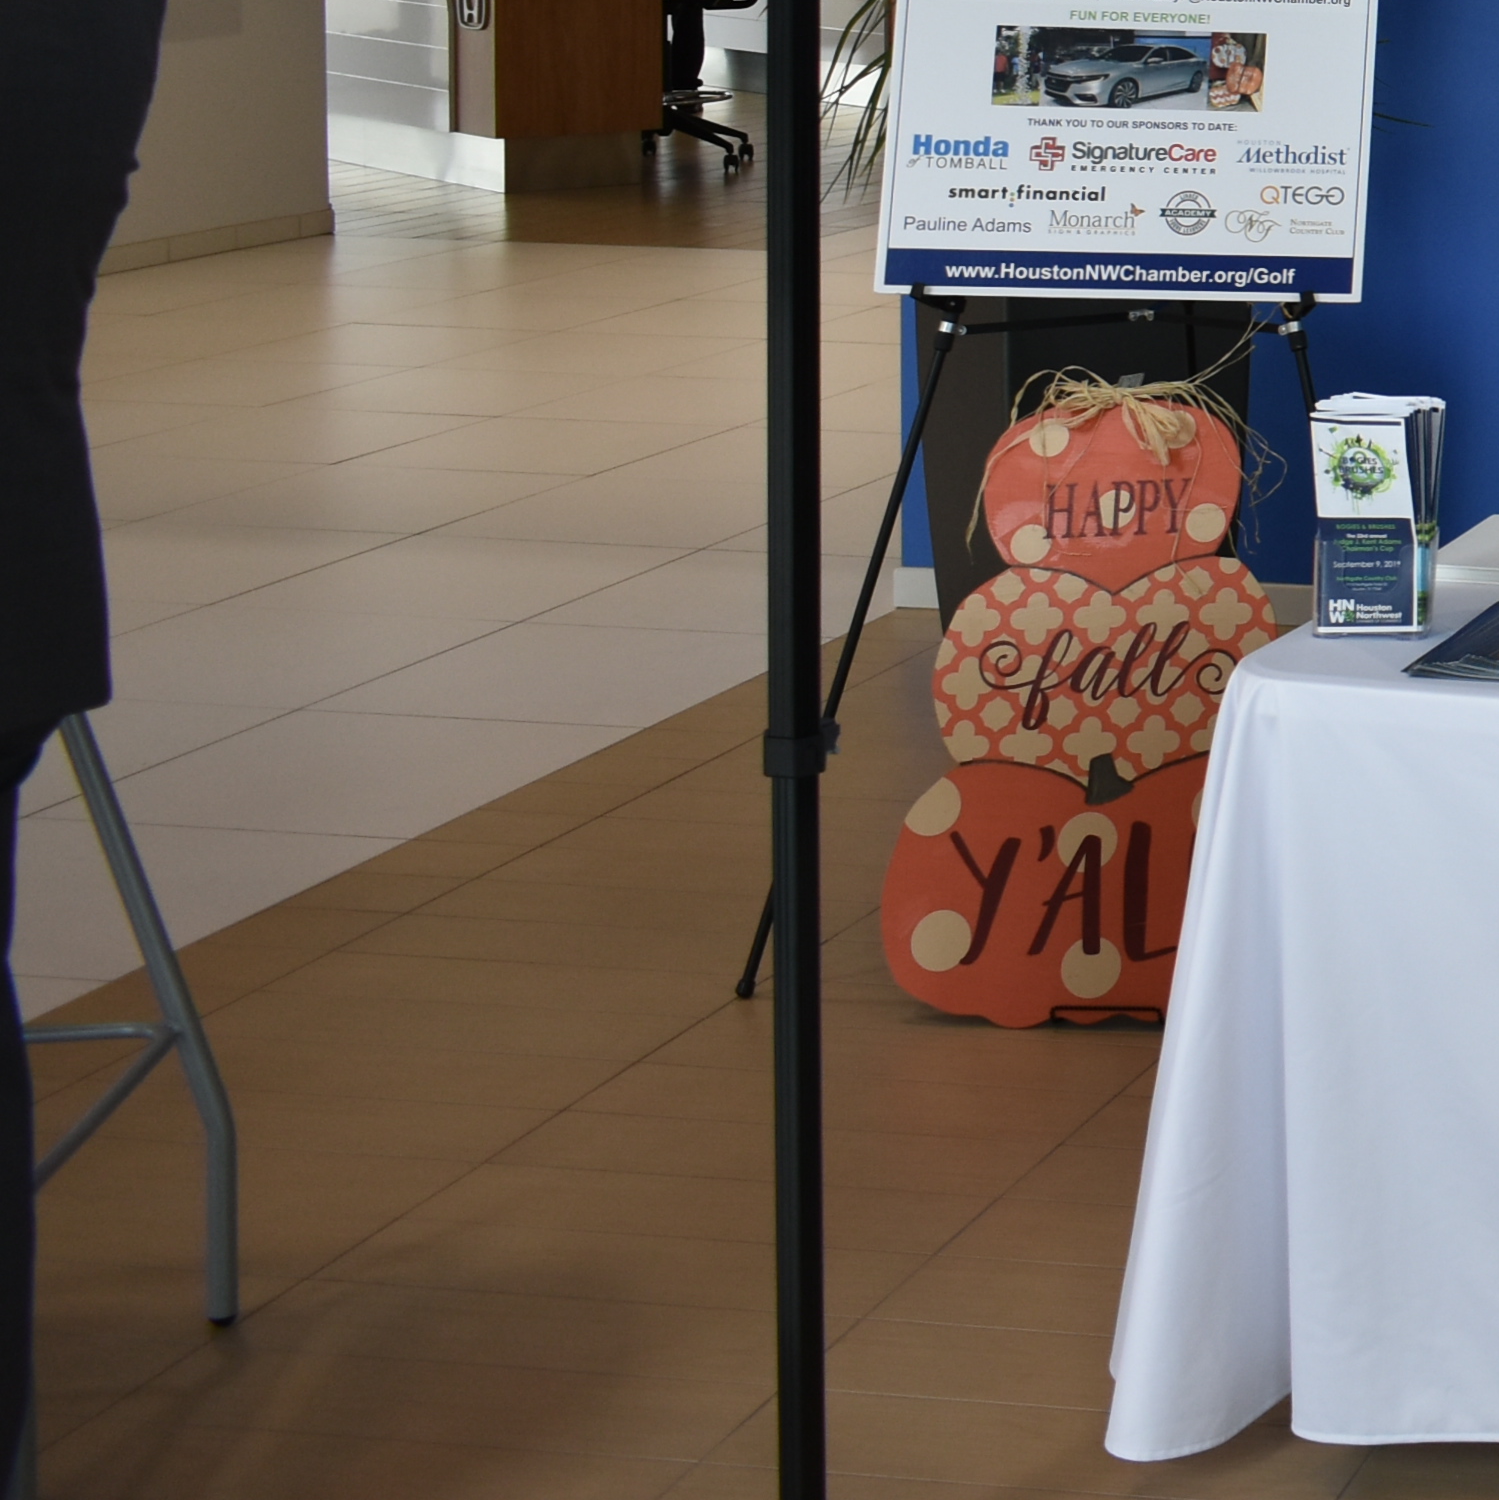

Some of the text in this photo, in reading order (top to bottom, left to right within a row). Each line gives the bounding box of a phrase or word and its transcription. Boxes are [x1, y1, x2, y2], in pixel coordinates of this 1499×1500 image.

[1069, 9, 1211, 24] FUN FOR EVERYONE!
[1027, 117, 1238, 132] THANK YOU TO OUR SPONSORS TO DATE:
[912, 133, 1010, 158] Honda
[1071, 140, 1217, 165] SignatureCare
[1236, 144, 1348, 166] Methodist
[926, 156, 1008, 170] TOMBALL
[1070, 164, 1217, 175] EMERGENCY CENTER
[903, 215, 1032, 234] Pauline Adams
[1048, 209, 1136, 229] Monarch
[944, 262, 1296, 288] www.HoustonNWChamber.org/Golf
[1043, 476, 1193, 541] HAPPY
[1356, 603, 1393, 612] Houston
[978, 620, 1240, 732] fall
[949, 819, 1197, 966] Y'AL
